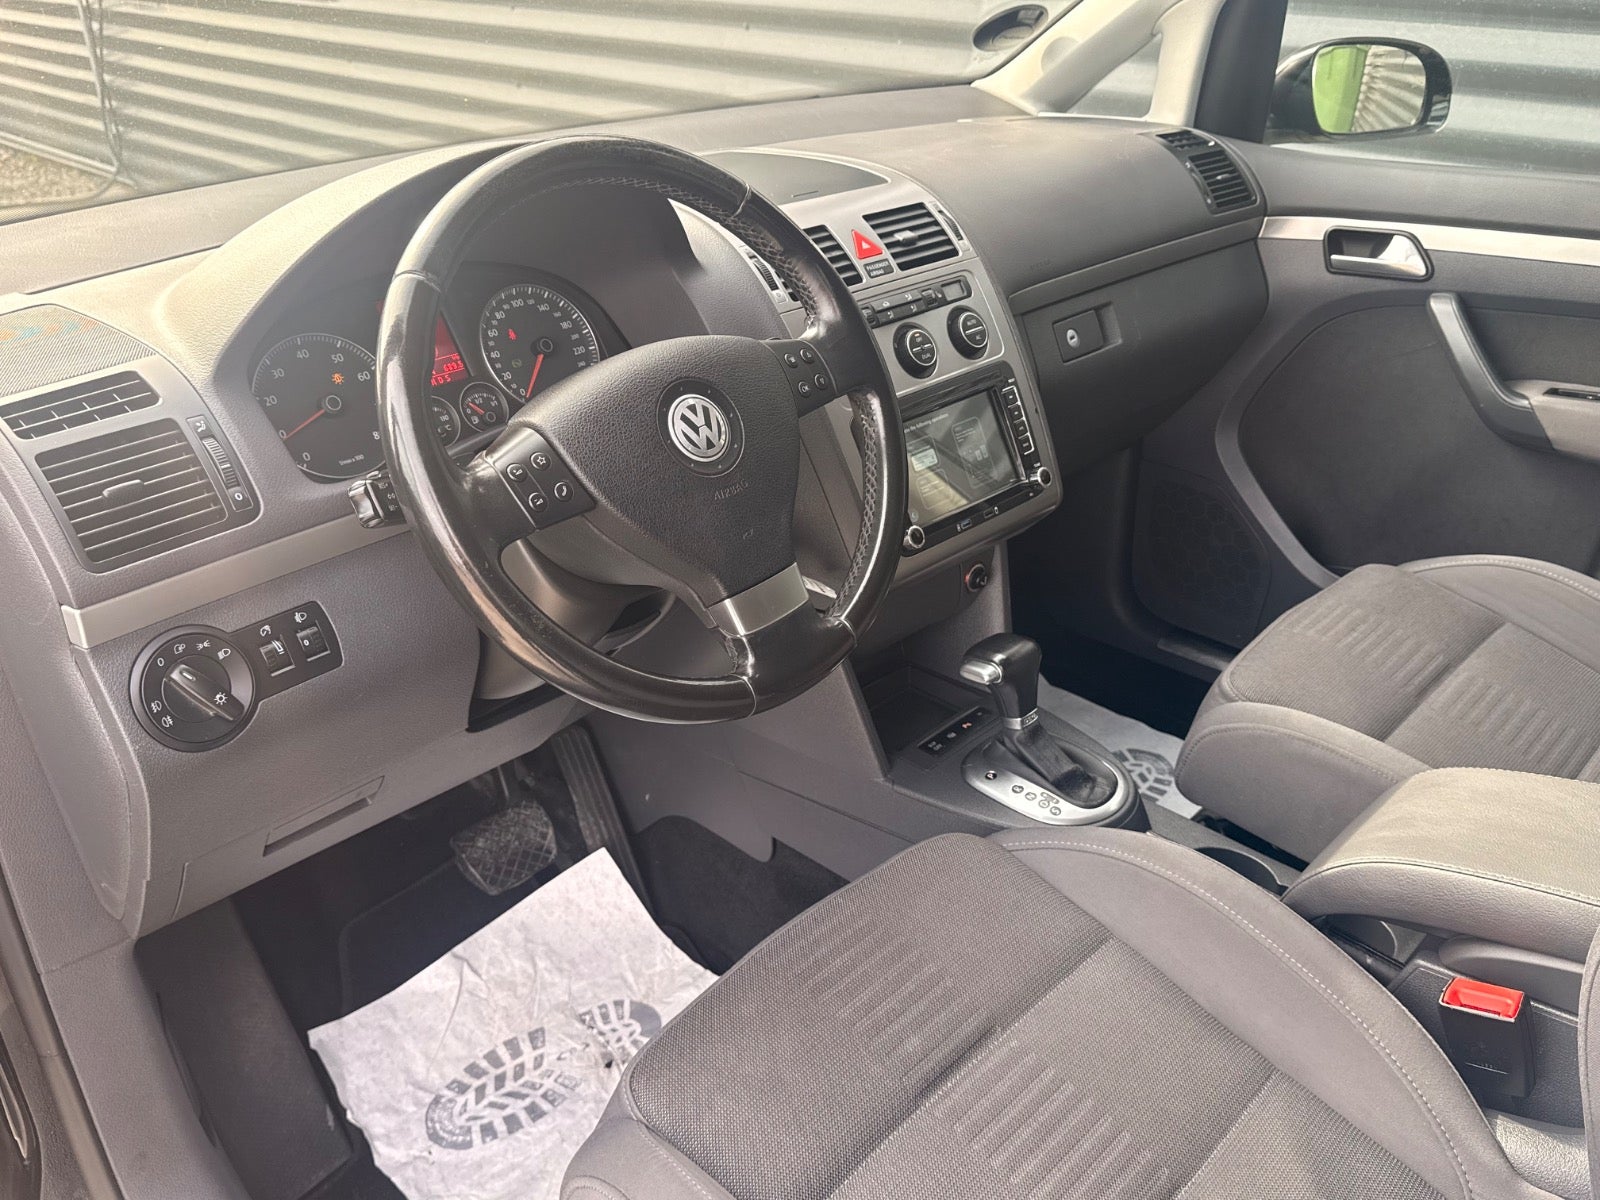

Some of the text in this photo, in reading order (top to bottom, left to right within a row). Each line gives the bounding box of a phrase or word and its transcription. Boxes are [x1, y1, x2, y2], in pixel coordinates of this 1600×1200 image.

[510, 298, 524, 308] 100
[536, 303, 550, 312] 140
[495, 311, 505, 320] 80
[560, 320, 573, 330] 180
[487, 328, 499, 338] 60
[297, 349, 310, 360] 40
[490, 350, 501, 359] 40
[572, 345, 586, 356] 220
[331, 353, 344, 364] 50
[271, 368, 285, 379] 30
[357, 371, 371, 382] 60
[501, 371, 512, 381] 20
[519, 388, 526, 397] 0
[264, 395, 278, 407] 20
[278, 429, 287, 439] 0
[302, 452, 311, 461] 0
[714, 478, 750, 501] AIRBAG
